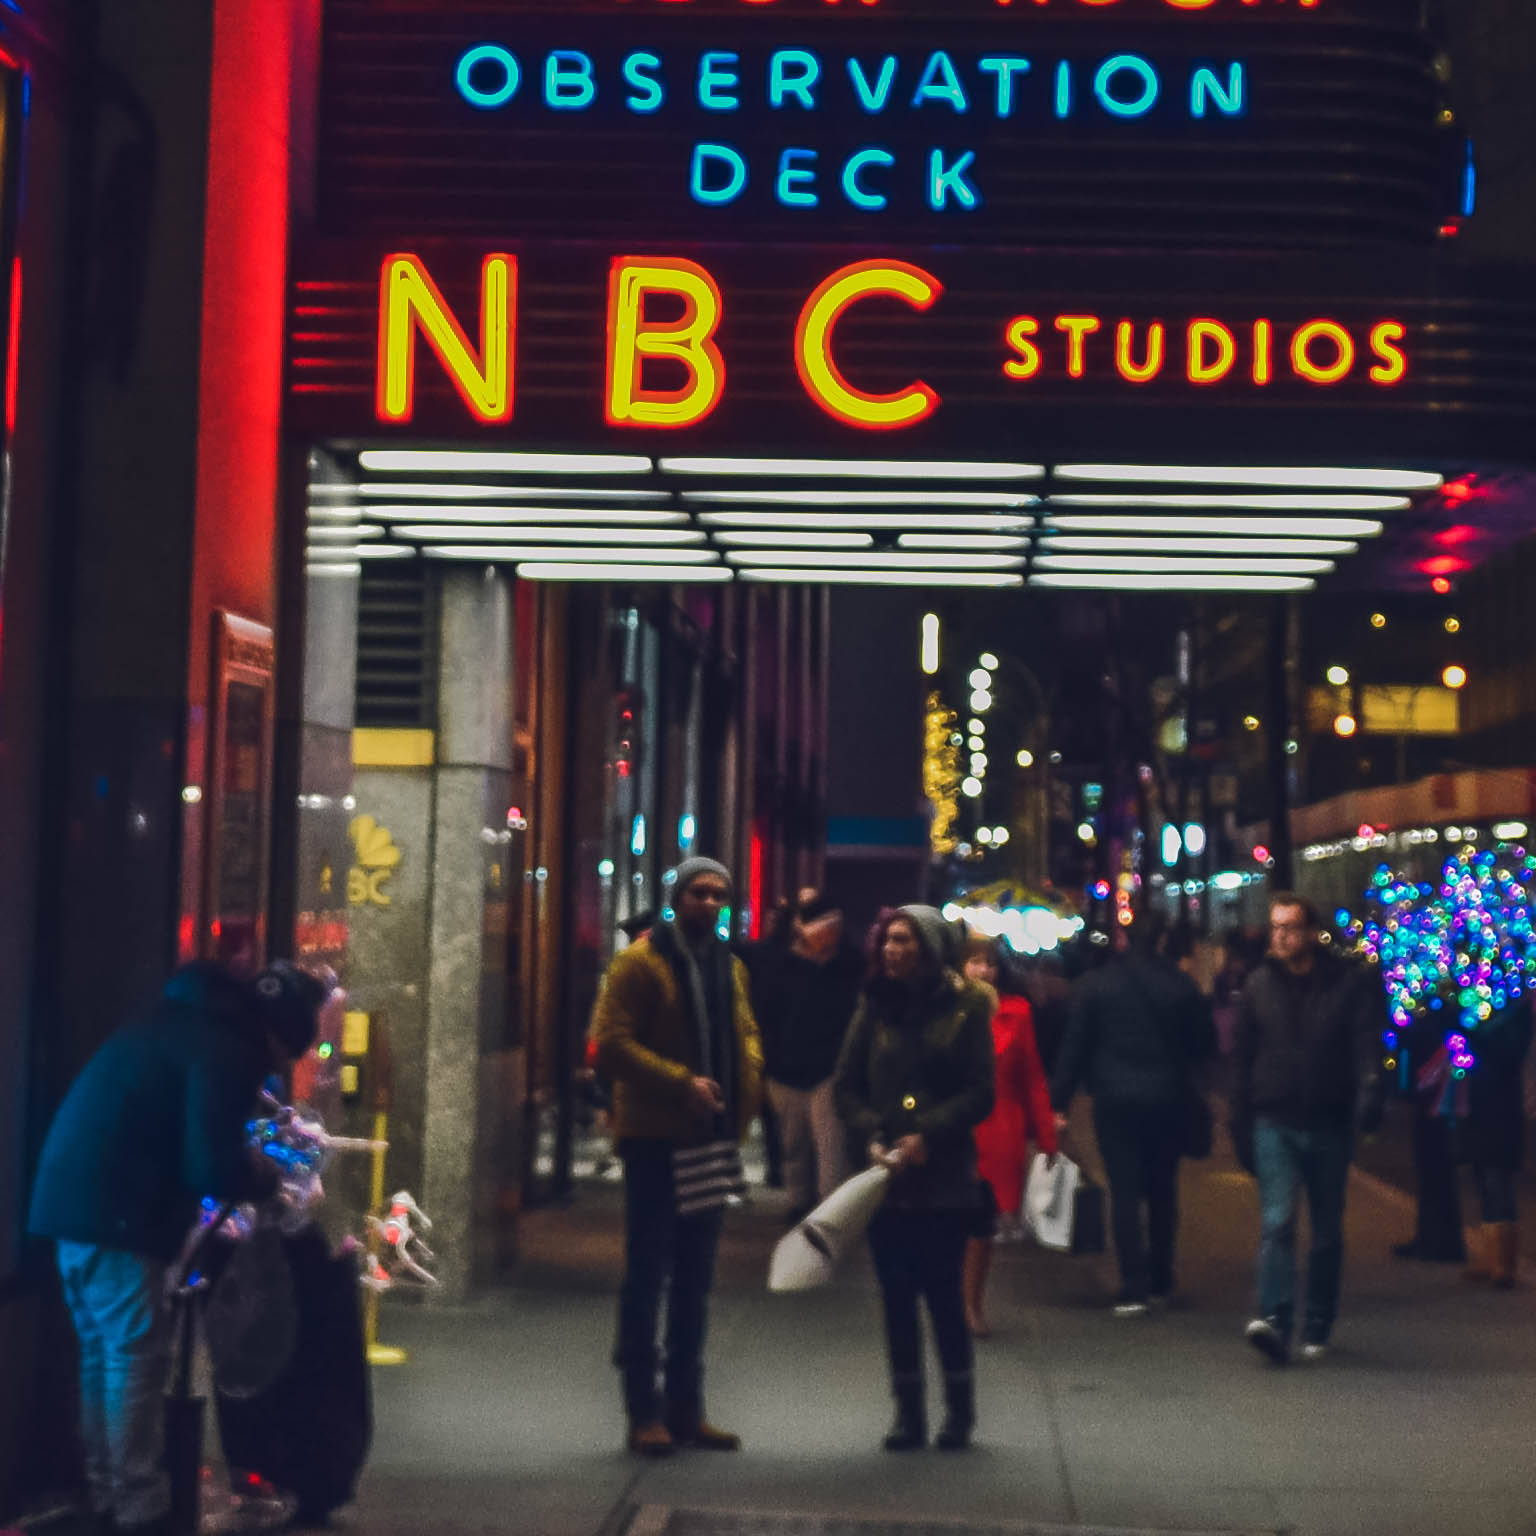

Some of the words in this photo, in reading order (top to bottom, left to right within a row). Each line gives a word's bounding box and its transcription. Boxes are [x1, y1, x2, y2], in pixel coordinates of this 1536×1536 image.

[454, 43, 1248, 118] OBSERVATION
[689, 141, 983, 210] DECK
[376, 251, 944, 429] NBC
[1002, 314, 1407, 386] STUDIOS
